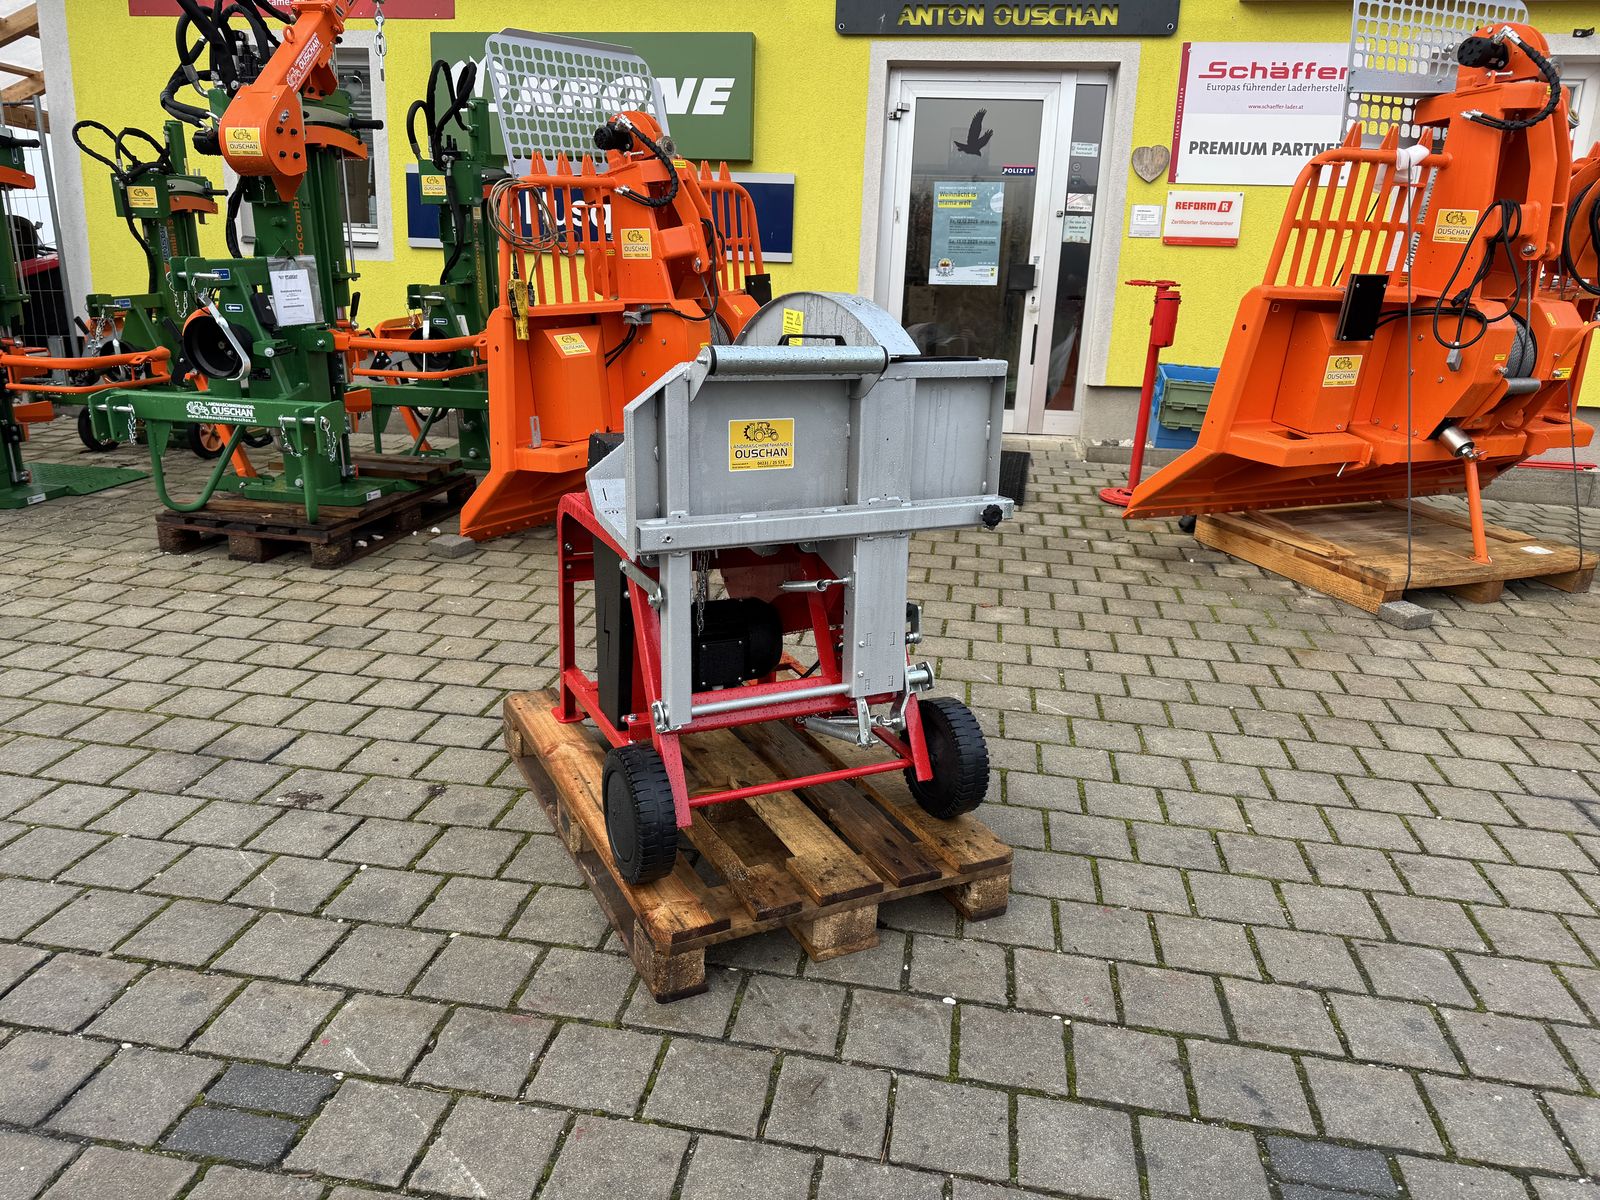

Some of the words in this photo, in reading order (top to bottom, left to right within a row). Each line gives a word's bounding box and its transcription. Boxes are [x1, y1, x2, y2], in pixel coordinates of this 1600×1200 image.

[898, 4, 985, 26] ANTON
[993, 4, 1119, 26] OUSCHAN
[1198, 61, 1348, 80] Schäffer
[1206, 83, 1241, 92] Europas
[1242, 83, 1285, 92] führender
[1188, 140, 1268, 156] PREMIUM
[1175, 201, 1217, 211] REFORM
[1437, 228, 1471, 236] OUSCHAN
[211, 406, 254, 417] OUSCHAN
[735, 447, 788, 459] OUSCHAN
